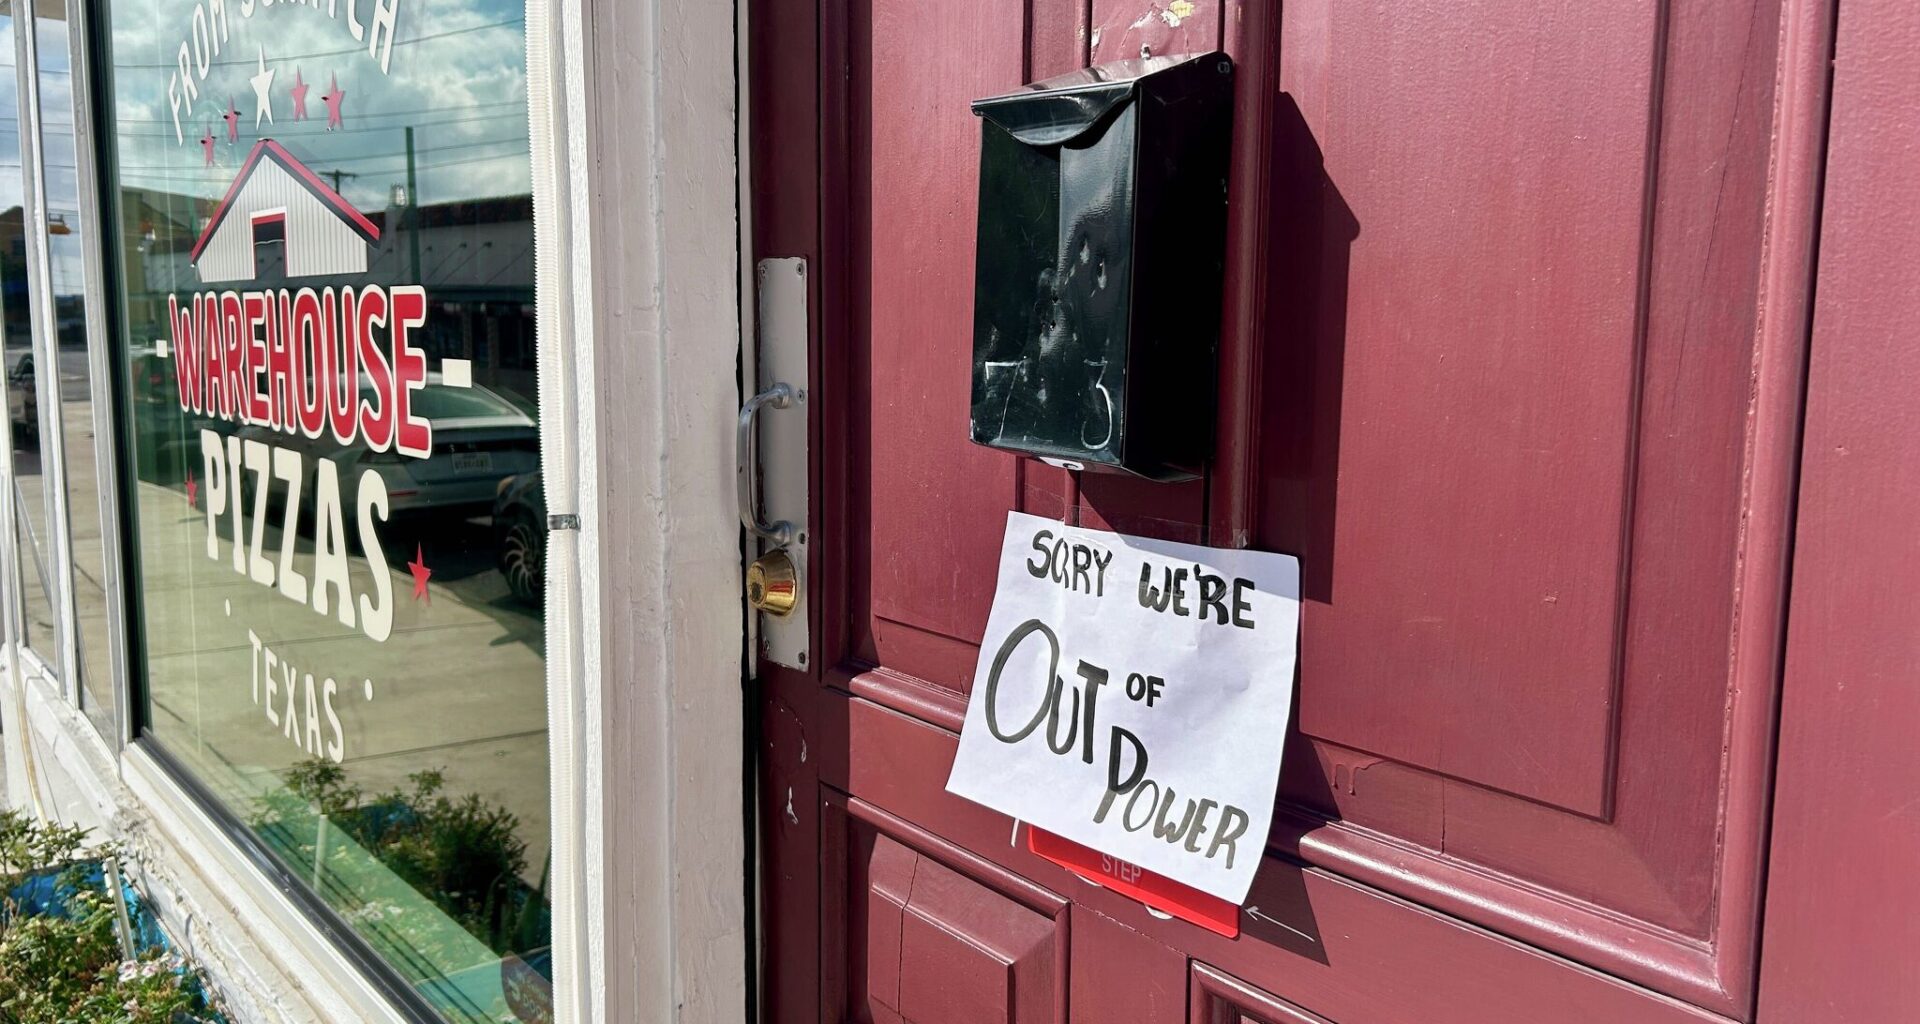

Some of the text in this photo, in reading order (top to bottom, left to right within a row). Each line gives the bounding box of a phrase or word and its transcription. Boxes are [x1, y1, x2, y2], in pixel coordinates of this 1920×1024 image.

[169, 0, 229, 147] FROM
[168, 284, 433, 459] WAREHOUSE
[201, 431, 396, 642] PIZZAS
[1138, 561, 1255, 629] WE'RE
[249, 629, 345, 764] TEXAS
[1125, 672, 1165, 707] OF
[1092, 725, 1249, 869] POWER
[1102, 853, 1141, 884] STEP
